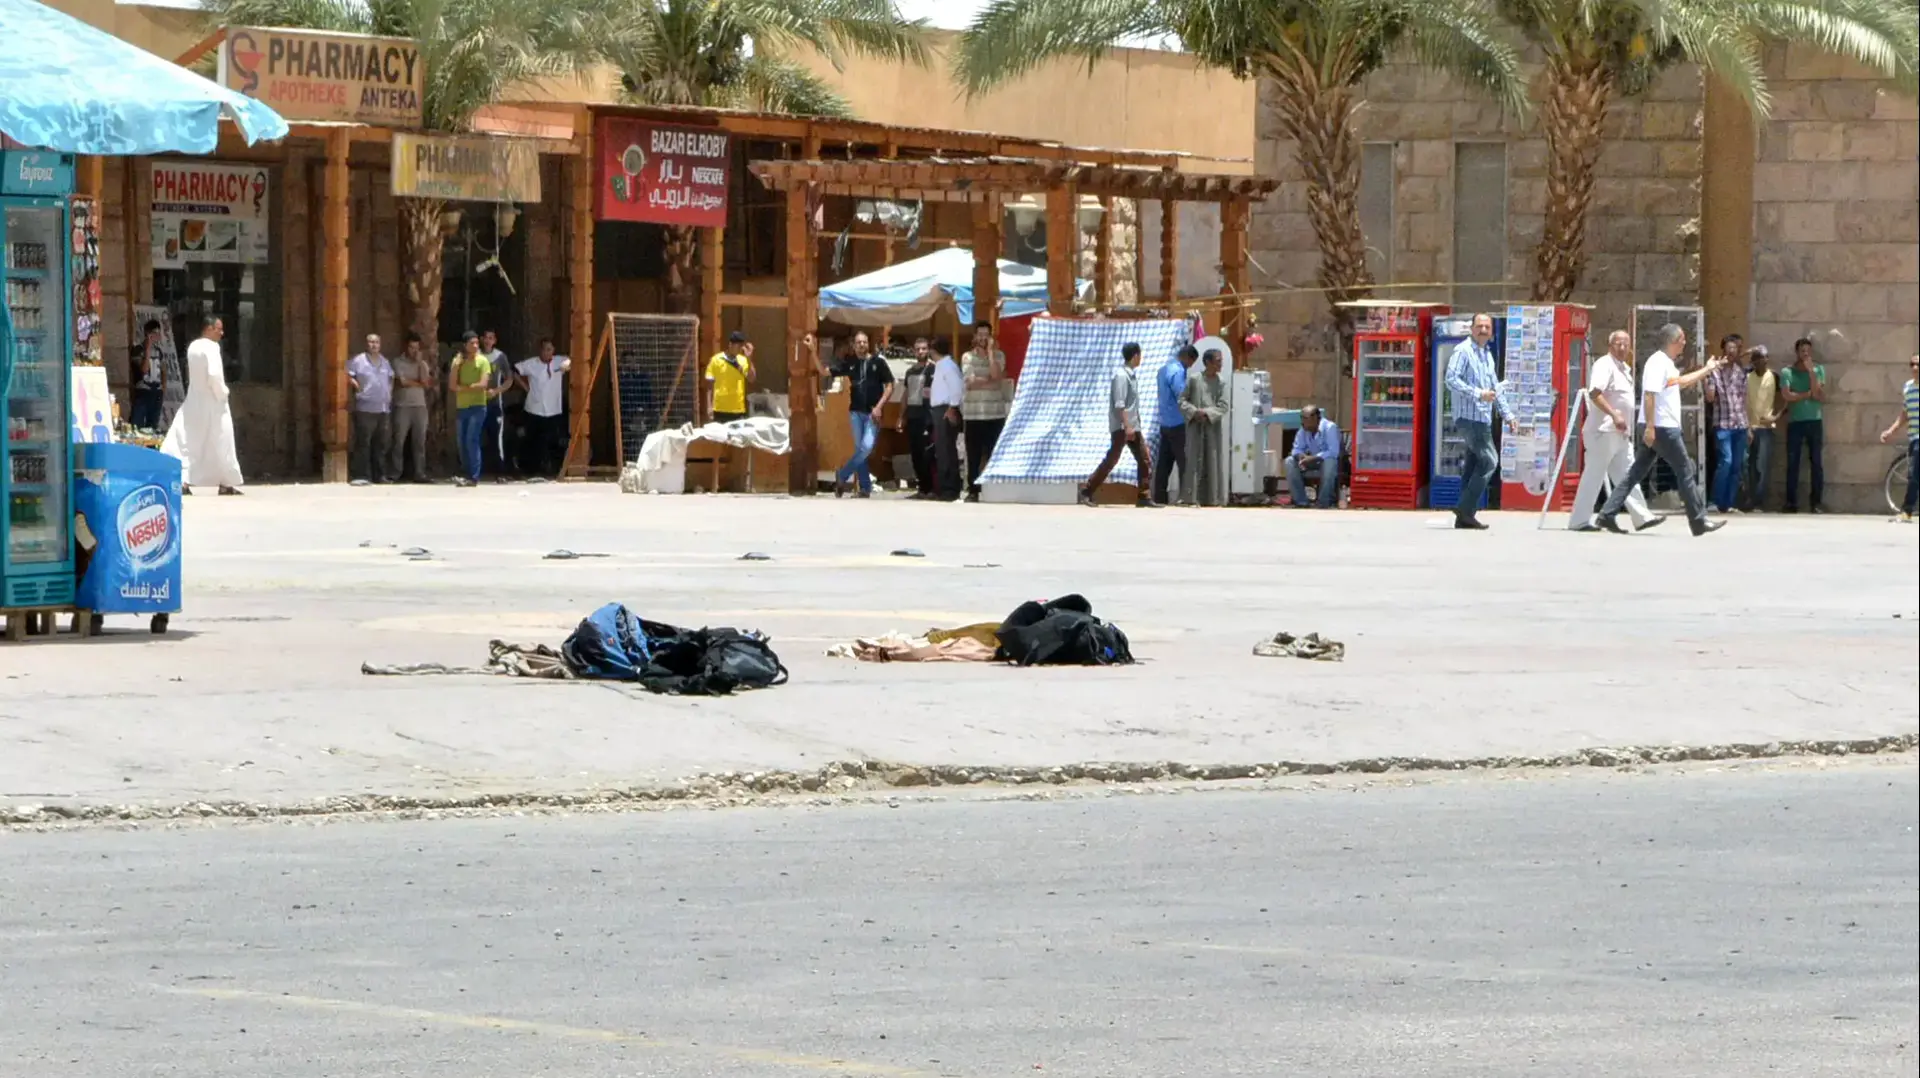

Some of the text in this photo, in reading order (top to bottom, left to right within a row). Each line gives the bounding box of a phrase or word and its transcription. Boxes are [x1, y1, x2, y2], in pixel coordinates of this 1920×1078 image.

[268, 37, 418, 85] PHARMACY
[268, 81, 417, 109] APOTHEKE ANTEKA
[651, 129, 727, 158] BAZAR ELROBY
[153, 168, 250, 204] PHARMACY
